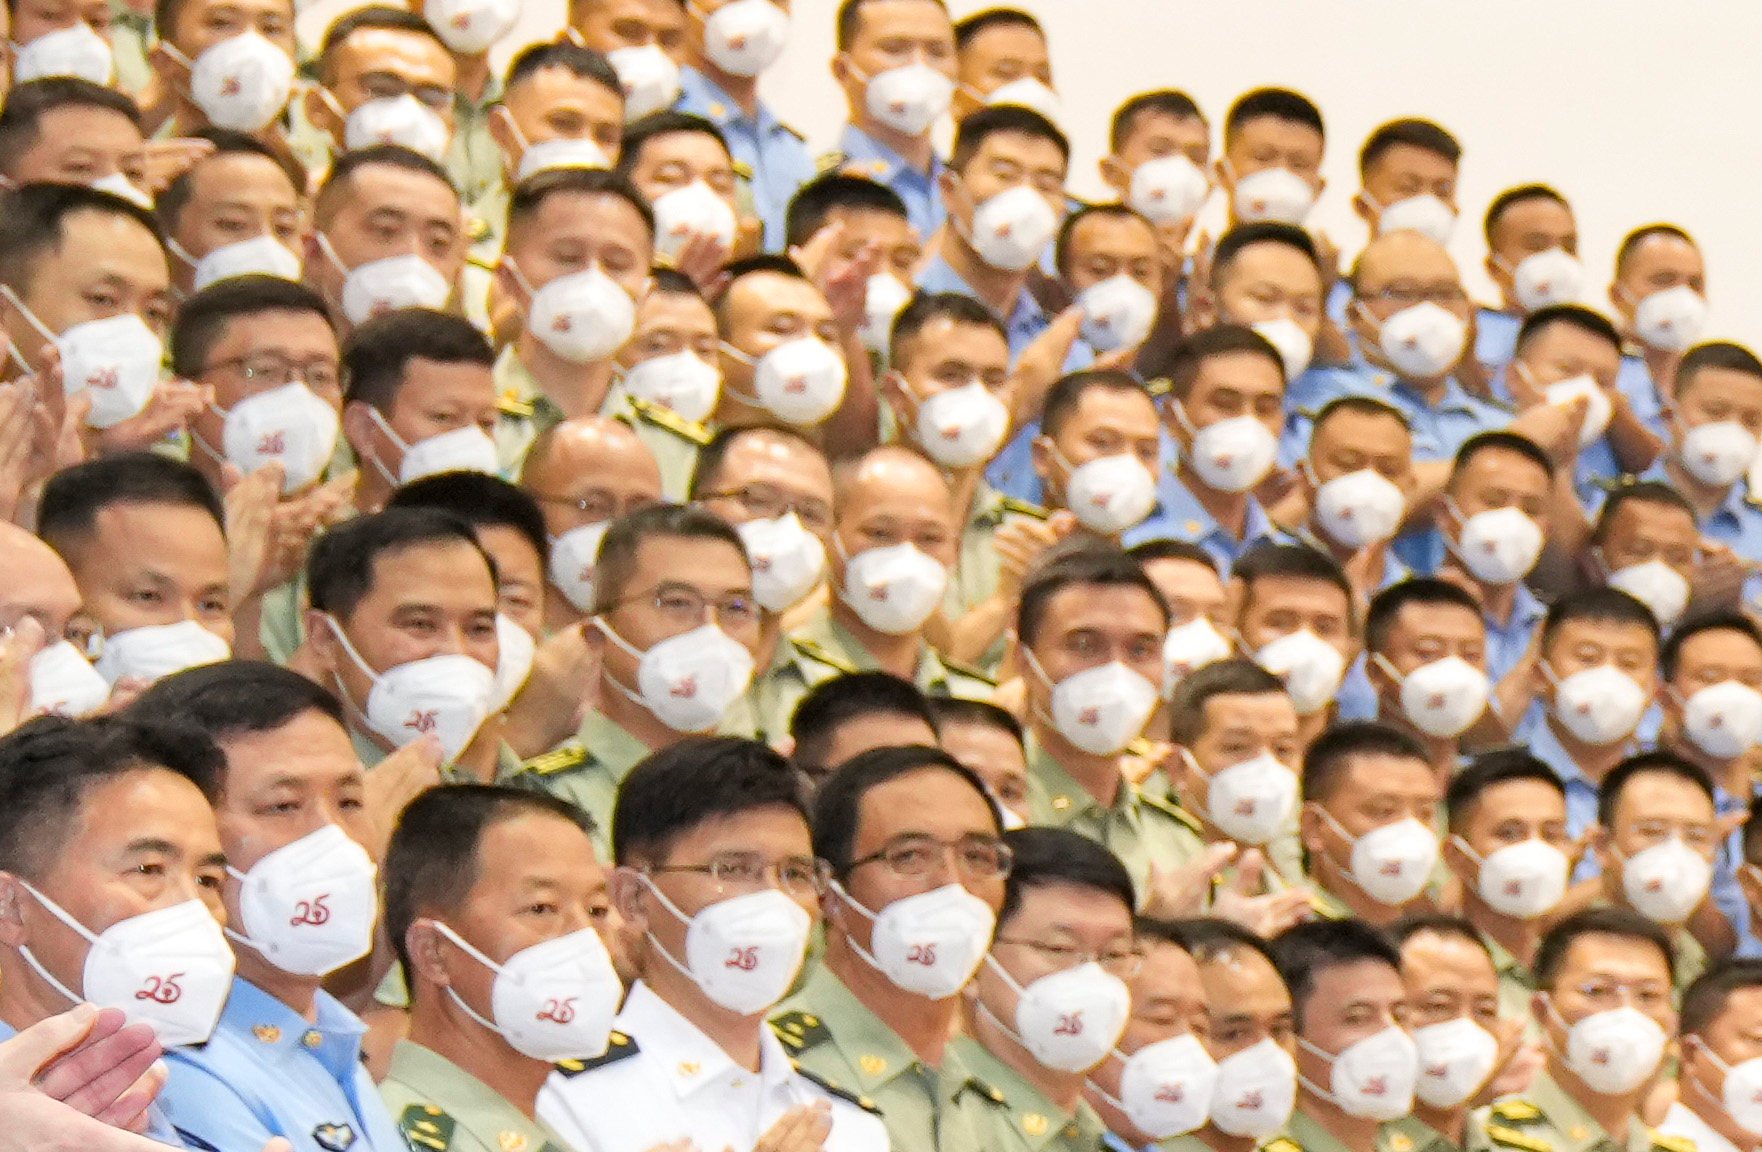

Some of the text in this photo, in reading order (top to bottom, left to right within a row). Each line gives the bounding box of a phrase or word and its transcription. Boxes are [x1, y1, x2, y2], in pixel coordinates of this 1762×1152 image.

[290, 894, 331, 927] 25
[725, 946, 759, 971] 25
[907, 943, 936, 966] 25
[135, 972, 185, 1004] 25
[535, 997, 579, 1025] 25
